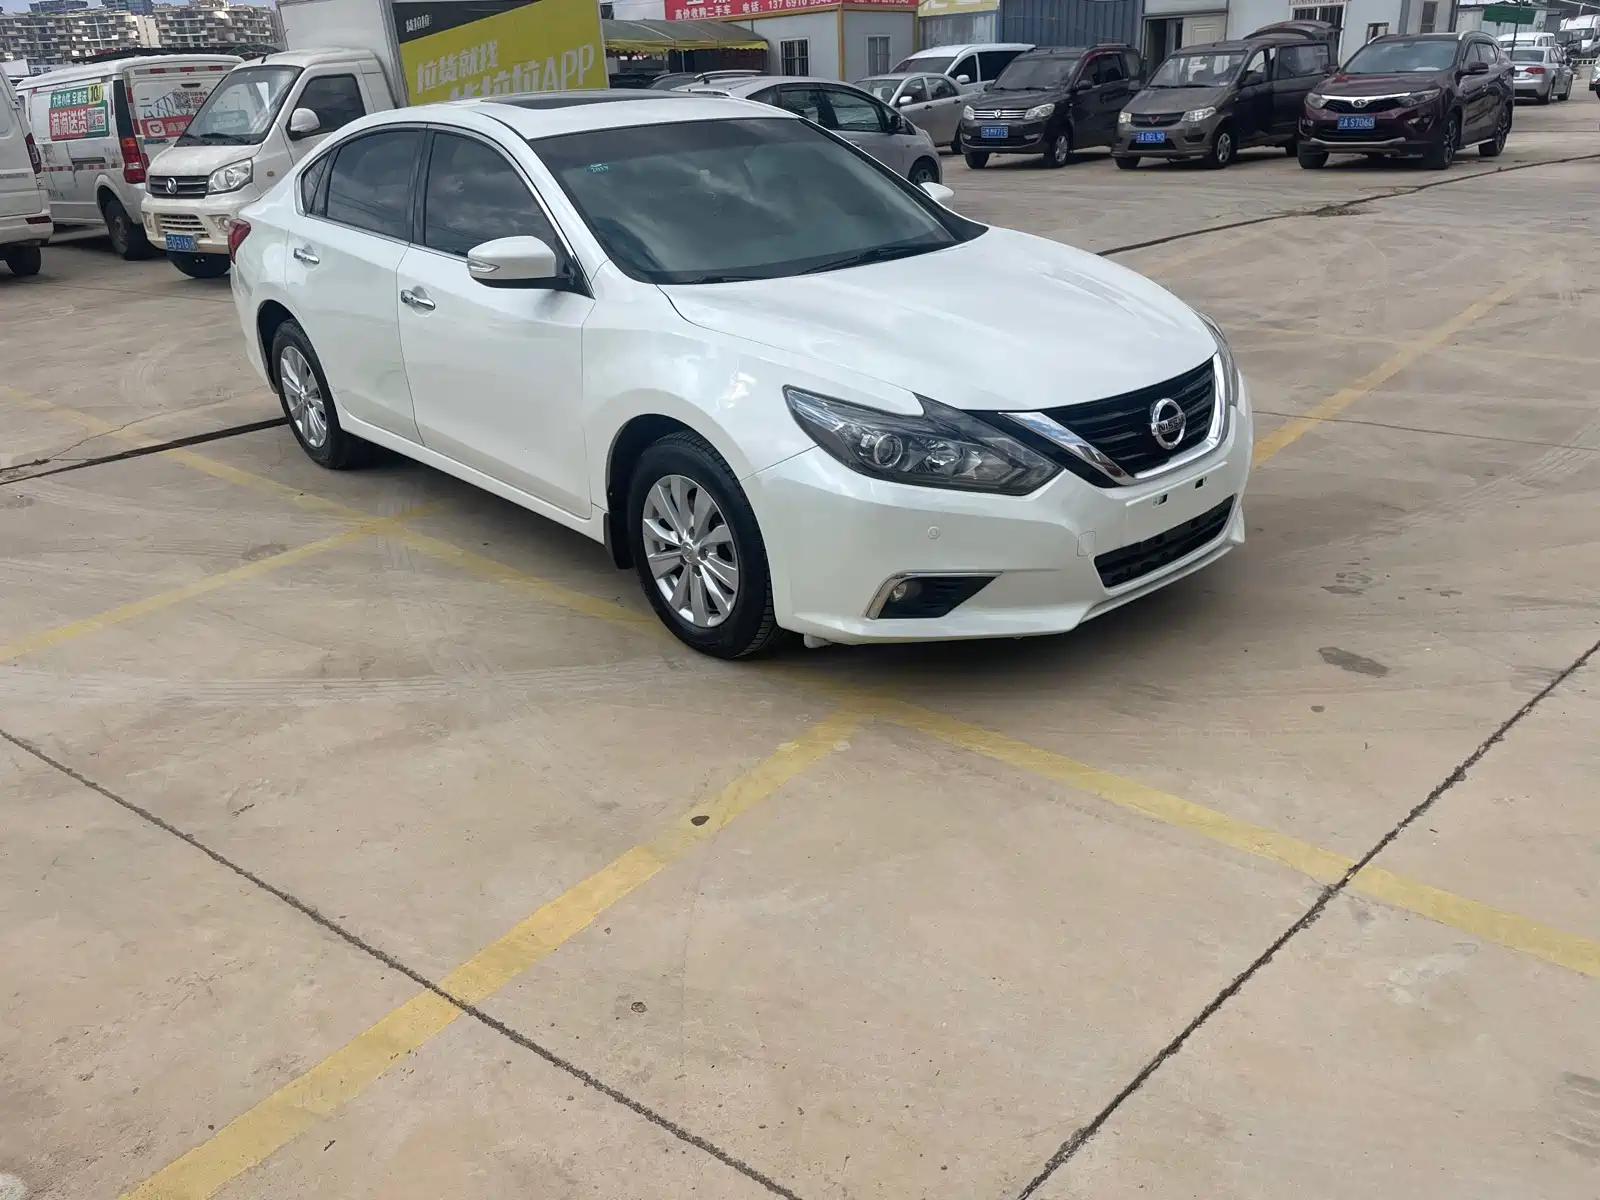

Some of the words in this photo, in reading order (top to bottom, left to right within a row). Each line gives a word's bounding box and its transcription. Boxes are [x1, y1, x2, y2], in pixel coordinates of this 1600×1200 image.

[675, 4, 731, 20] 高价收购二手车
[768, 0, 782, 9] 137
[416, 40, 498, 95] 拉货就找
[50, 109, 88, 136] 滴滴送货
